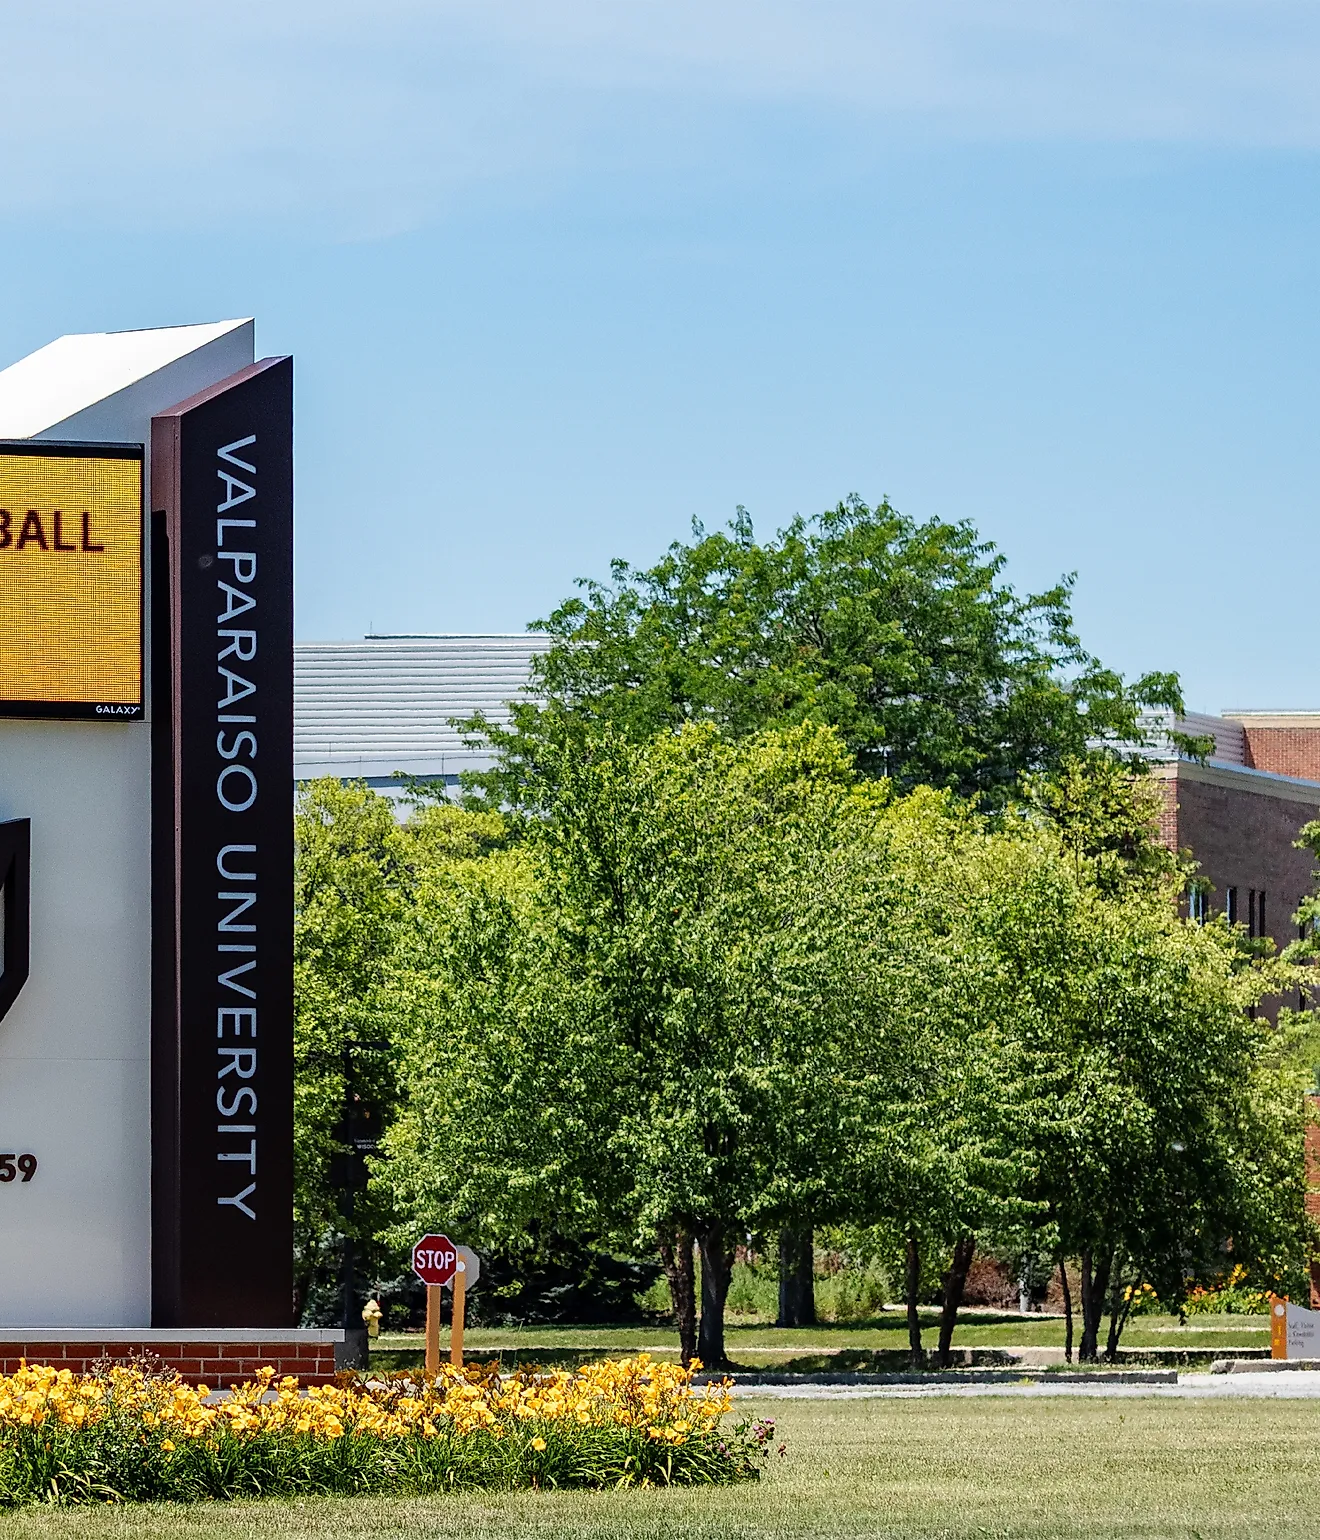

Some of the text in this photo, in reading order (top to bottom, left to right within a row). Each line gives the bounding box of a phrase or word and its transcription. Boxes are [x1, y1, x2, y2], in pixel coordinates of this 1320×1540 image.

[216, 434, 258, 1221] VALPARAISO UNIVERSITY
[416, 1249, 455, 1270] STOP
